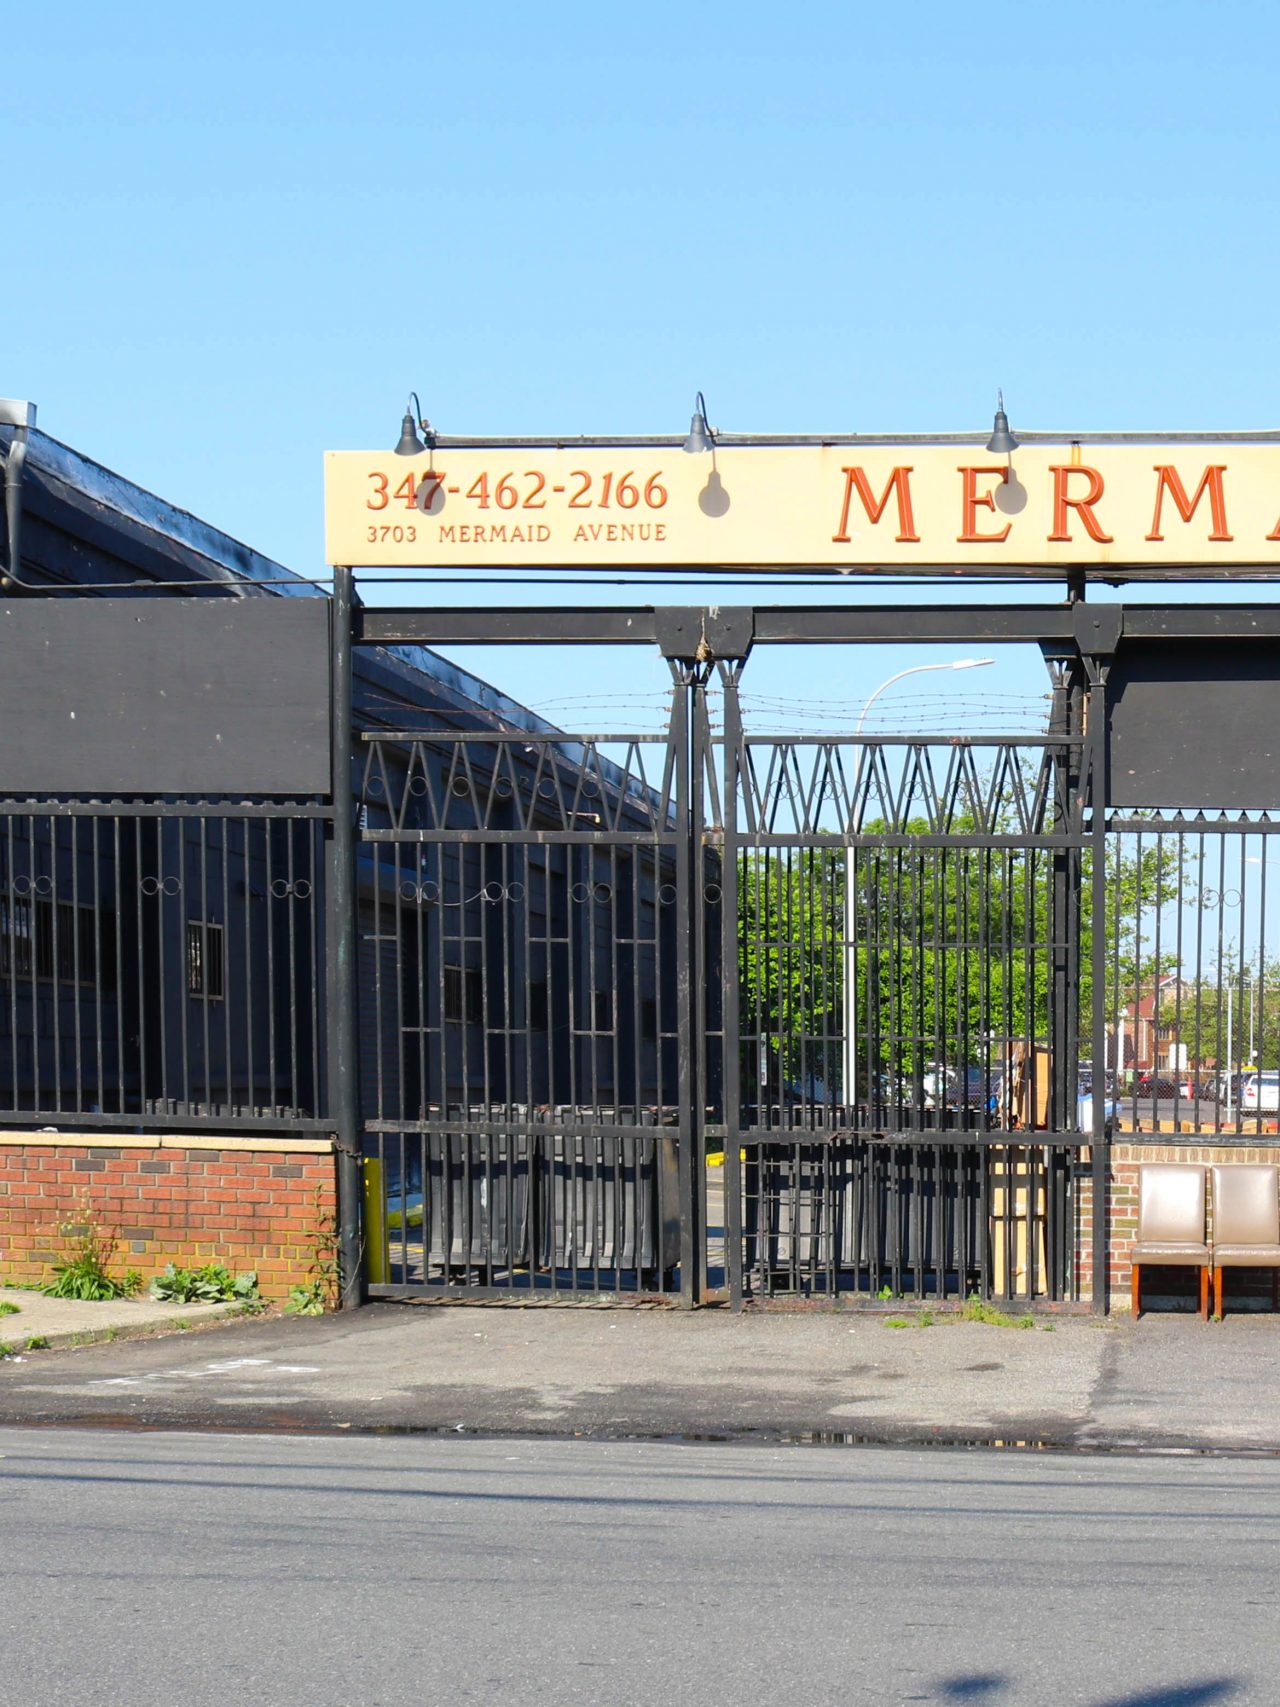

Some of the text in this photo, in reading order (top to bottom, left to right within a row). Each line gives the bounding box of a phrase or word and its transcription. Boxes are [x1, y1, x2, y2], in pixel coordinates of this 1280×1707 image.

[366, 469, 669, 511] 347-462-2166
[366, 523, 668, 544] 3703 MERMAID AVENUE
